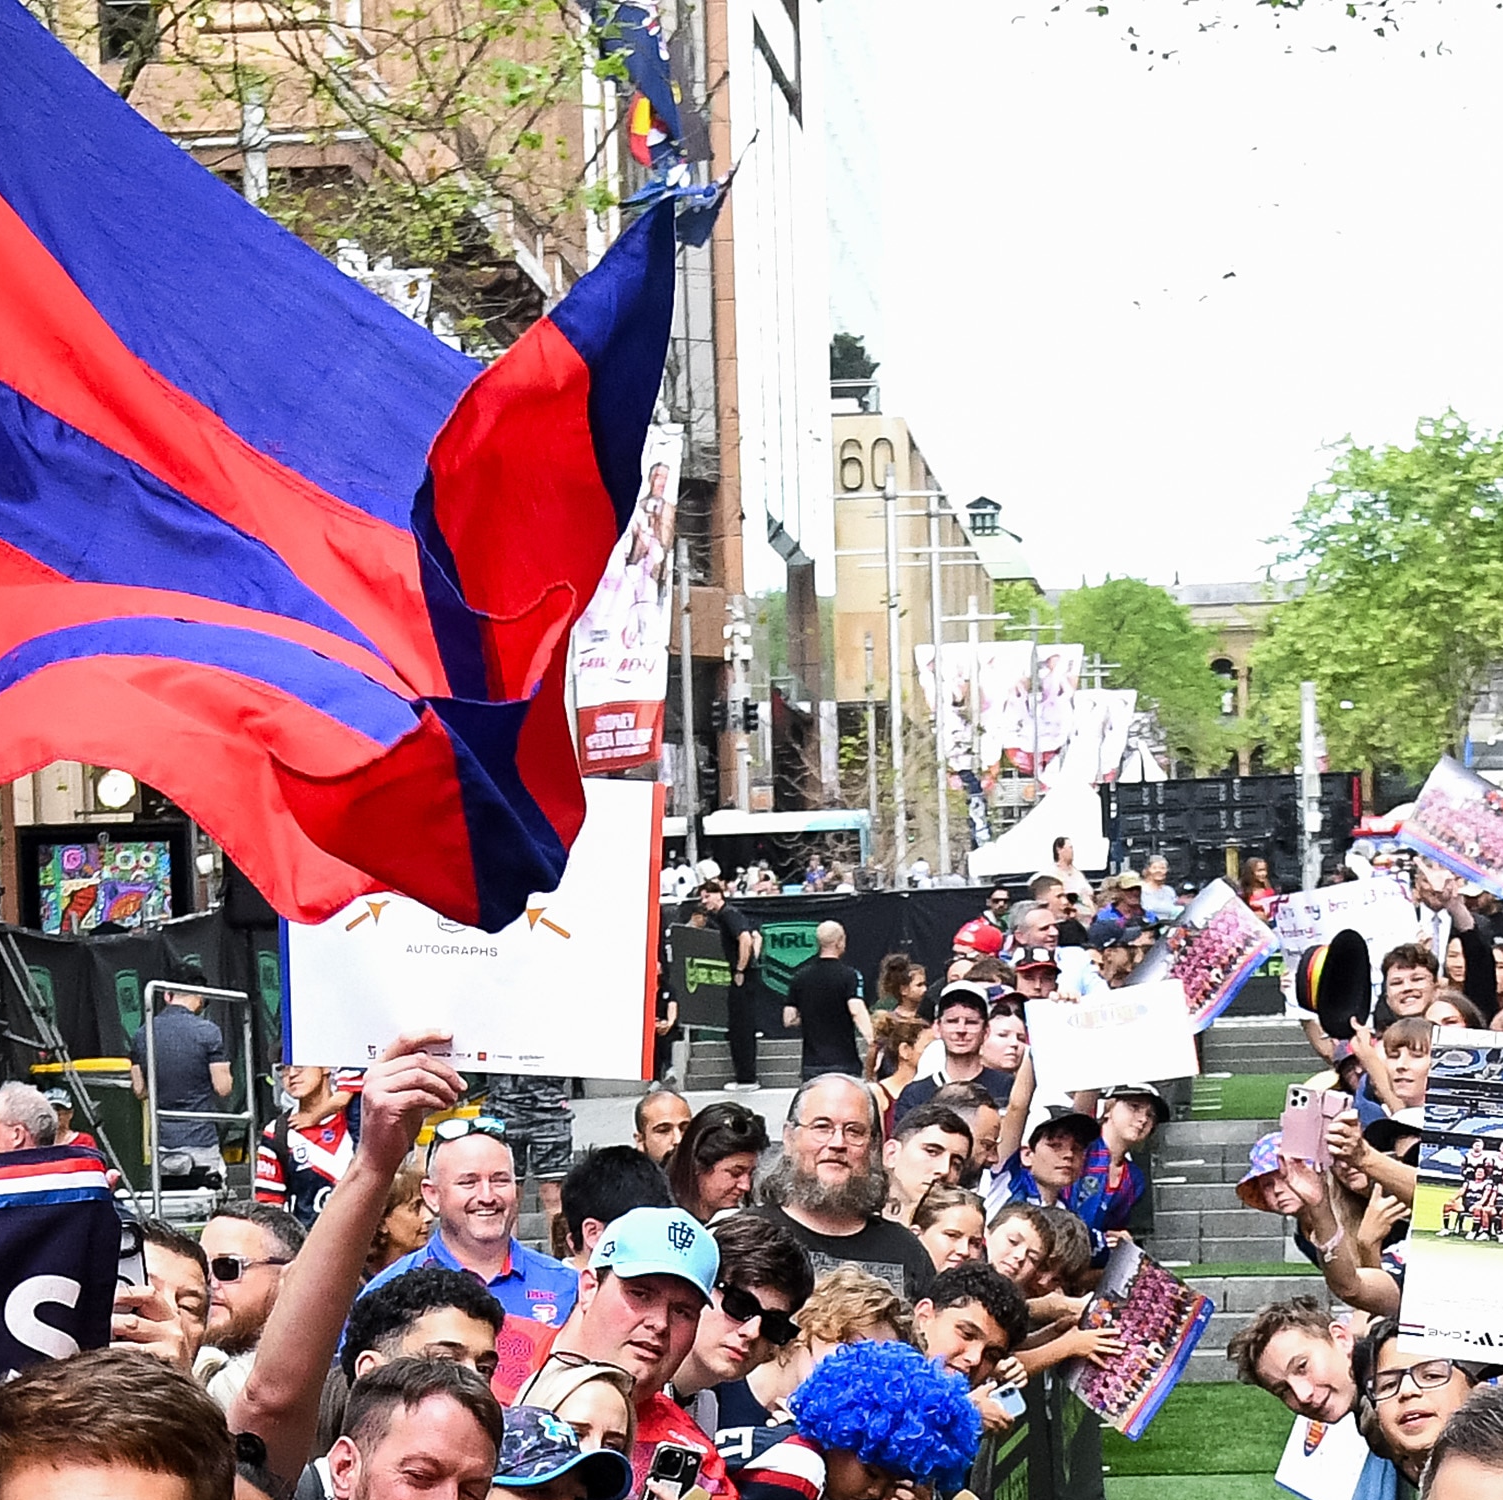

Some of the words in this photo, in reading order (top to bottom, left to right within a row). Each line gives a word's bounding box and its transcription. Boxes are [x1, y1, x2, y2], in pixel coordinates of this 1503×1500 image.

[839, 437, 896, 492] 60
[769, 931, 814, 949] NRL
[406, 943, 498, 958] AUTOGRAPHS
